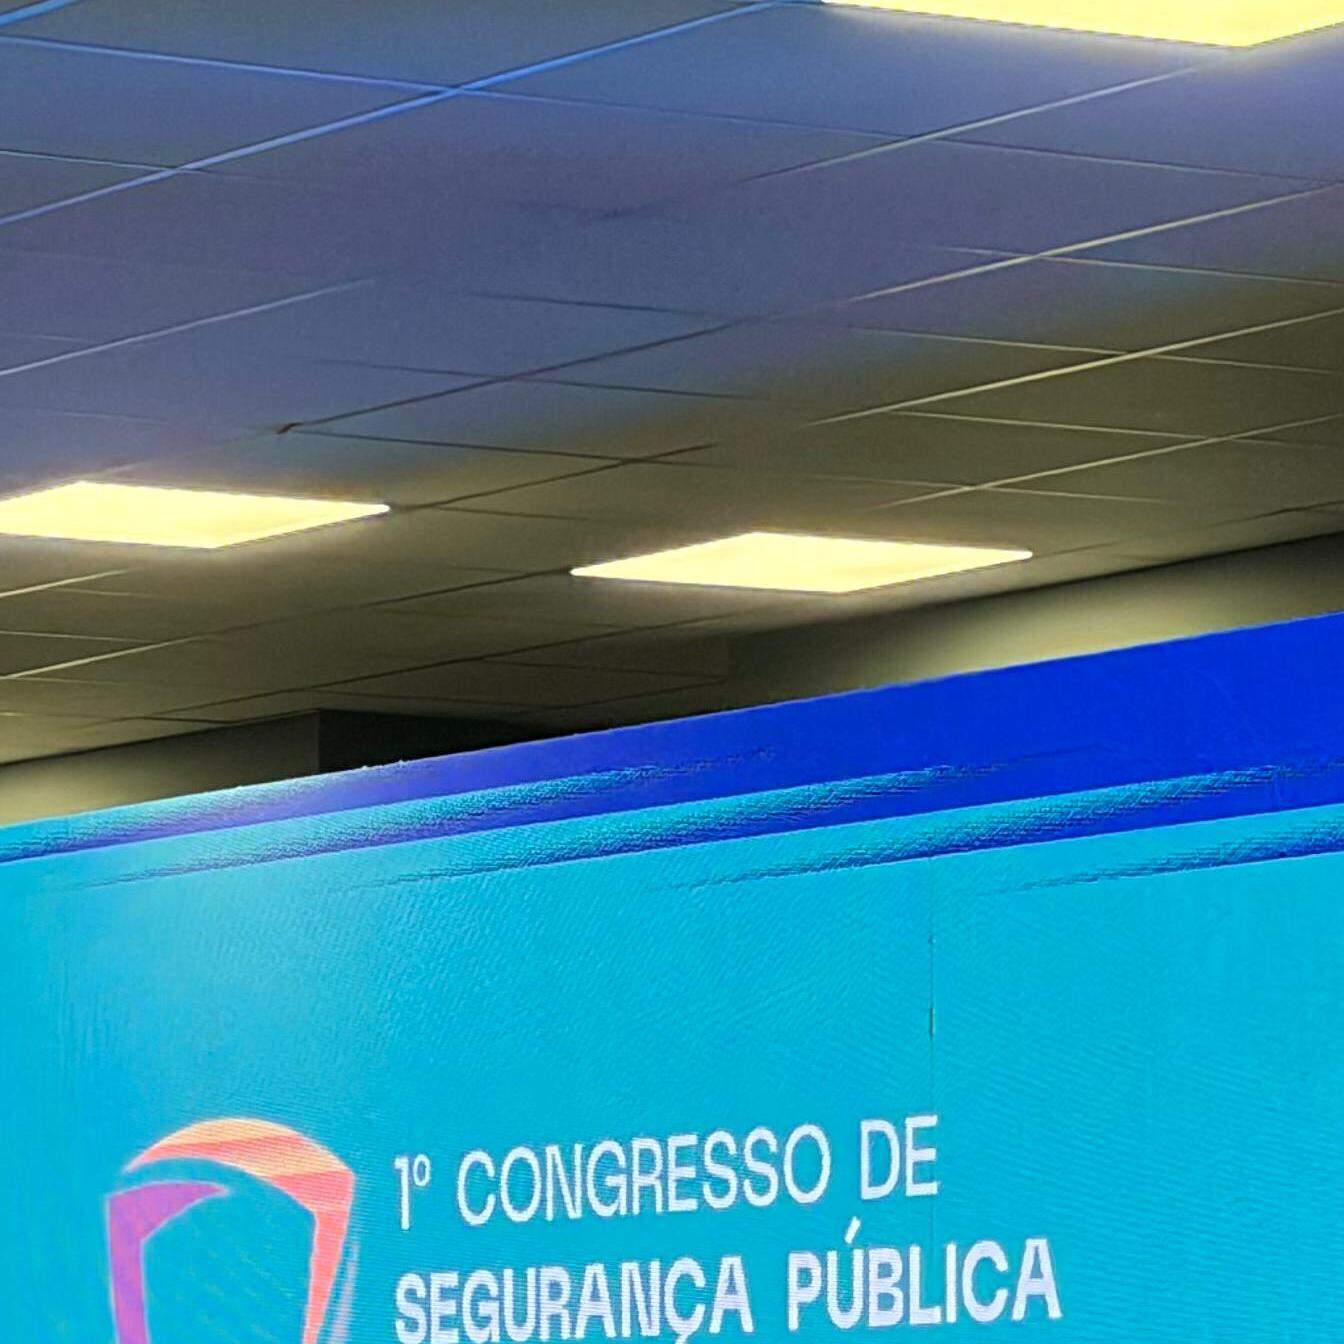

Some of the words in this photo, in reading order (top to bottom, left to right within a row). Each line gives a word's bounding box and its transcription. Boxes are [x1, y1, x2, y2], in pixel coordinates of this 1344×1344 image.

[456, 1124, 832, 1226] CONGRESSO
[860, 1114, 940, 1201] DE
[787, 1216, 1063, 1332] PÚBLICA
